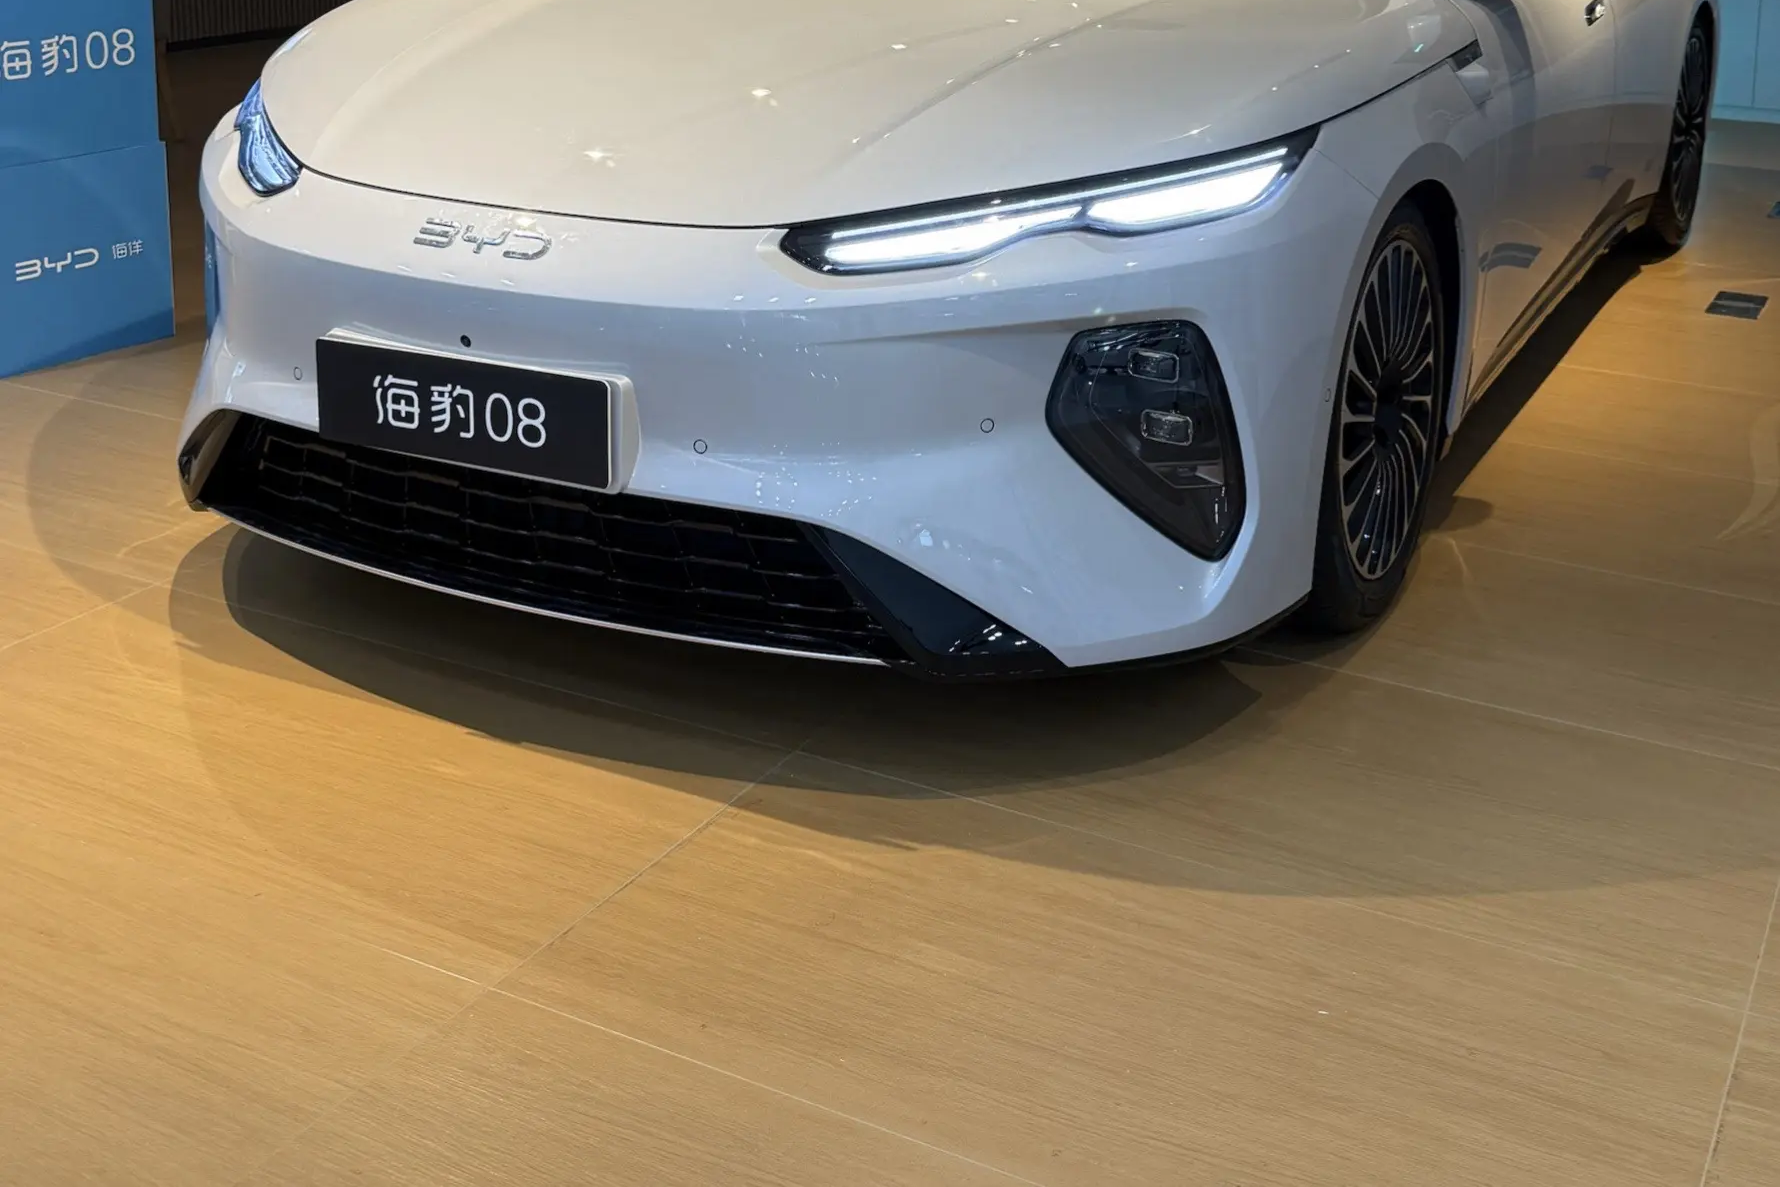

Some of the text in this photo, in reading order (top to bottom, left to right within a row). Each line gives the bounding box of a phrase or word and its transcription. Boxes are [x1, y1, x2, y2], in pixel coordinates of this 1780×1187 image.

[0, 28, 136, 80] 海豹08
[15, 240, 144, 282] BYD 海洋
[413, 217, 552, 260] BYD
[373, 374, 547, 448] 海豹08
